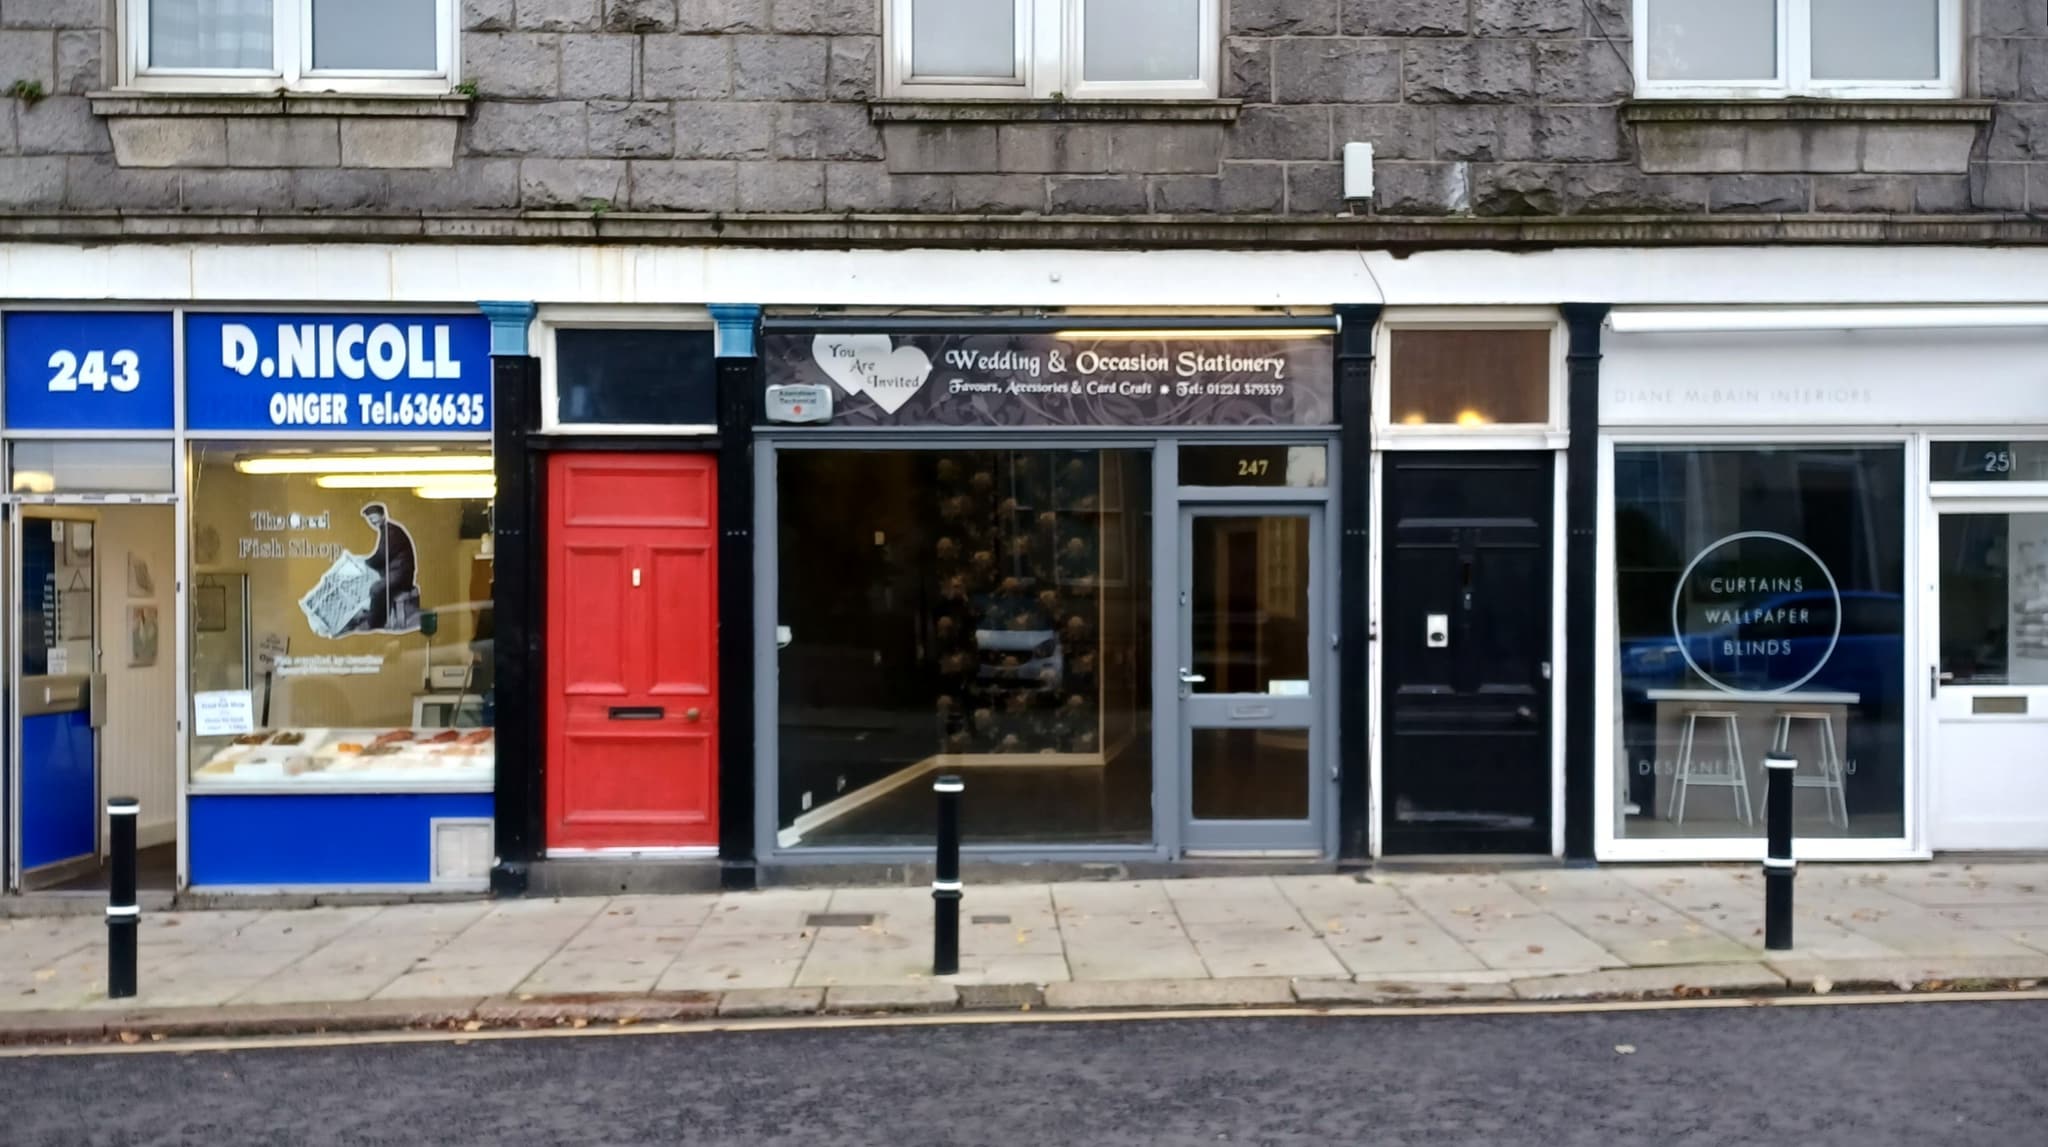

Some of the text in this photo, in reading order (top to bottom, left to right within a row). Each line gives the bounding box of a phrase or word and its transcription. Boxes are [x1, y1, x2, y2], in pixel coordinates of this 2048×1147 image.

[221, 323, 461, 380] D.NICOLL
[828, 344, 855, 358] You
[48, 349, 140, 392] 243
[849, 360, 876, 375] Are
[945, 349, 1285, 379] Wedding & Occasion Stationery
[867, 375, 919, 388] Invited
[1005, 381, 1068, 395] Accessories
[1070, 381, 1082, 395] &
[1086, 381, 1117, 395] Card
[1119, 381, 1152, 396] Craft
[1615, 388, 1673, 403] DIANE
[1770, 388, 1872, 403] INTERIORS
[269, 391, 485, 425] ONGER Tel.636635
[1237, 459, 1269, 477] 247
[1984, 451, 2017, 472] 251
[250, 510, 285, 531] The
[239, 538, 343, 563] Fish Shop
[1711, 577, 1803, 593] CURTAINS
[1705, 608, 1809, 624] WALLPAPER
[1723, 640, 1792, 656] BLINDS
